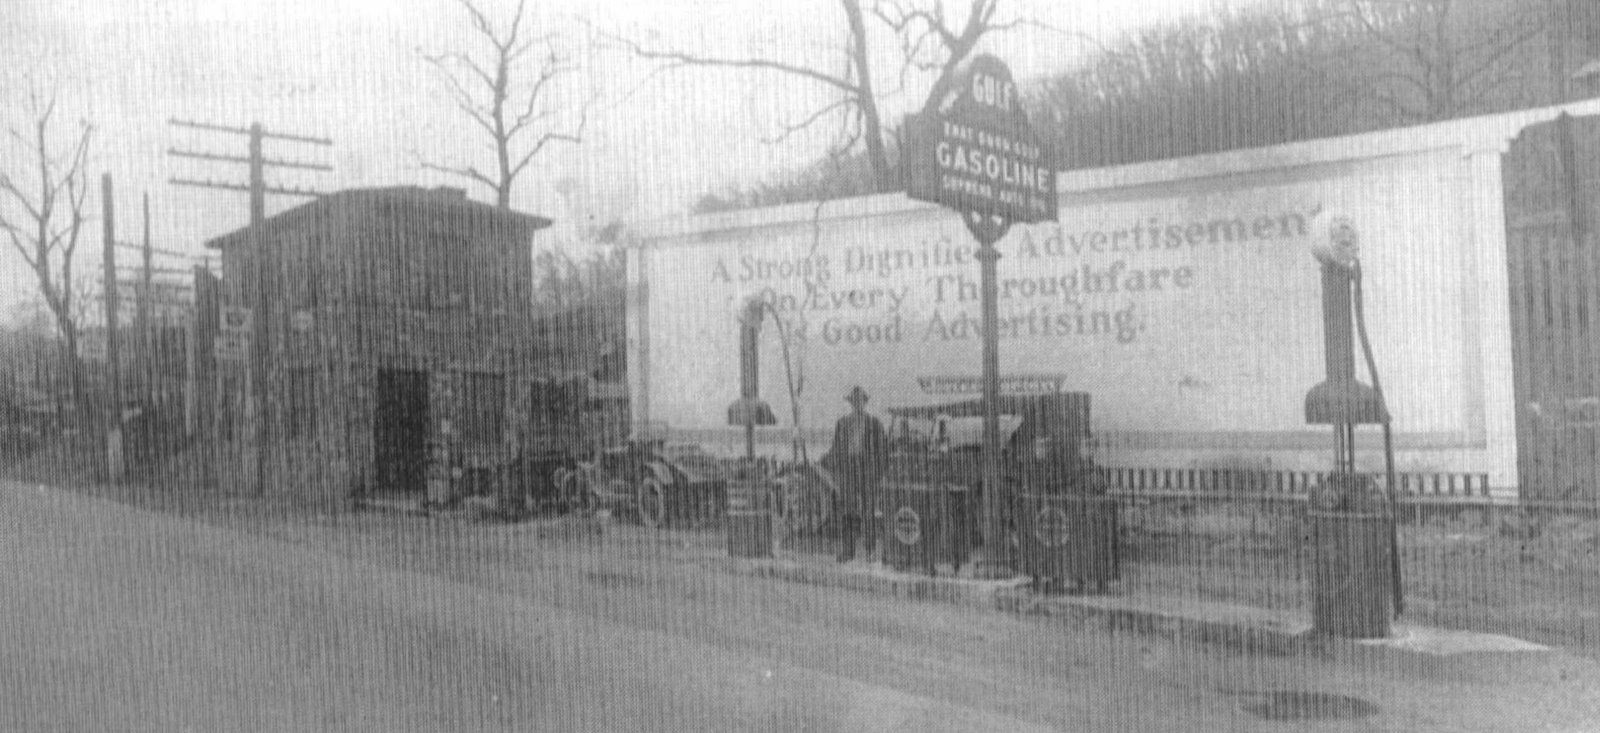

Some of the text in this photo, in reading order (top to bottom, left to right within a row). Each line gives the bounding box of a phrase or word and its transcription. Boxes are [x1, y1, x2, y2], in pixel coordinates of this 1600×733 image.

[973, 73, 1012, 111] GULF
[936, 141, 1050, 192] GASOLINE
[710, 256, 732, 284] A
[738, 253, 832, 289] Strong
[844, 237, 973, 279] Dignifie
[759, 259, 1195, 313] On Every Throughfare
[821, 313, 903, 347] Good
